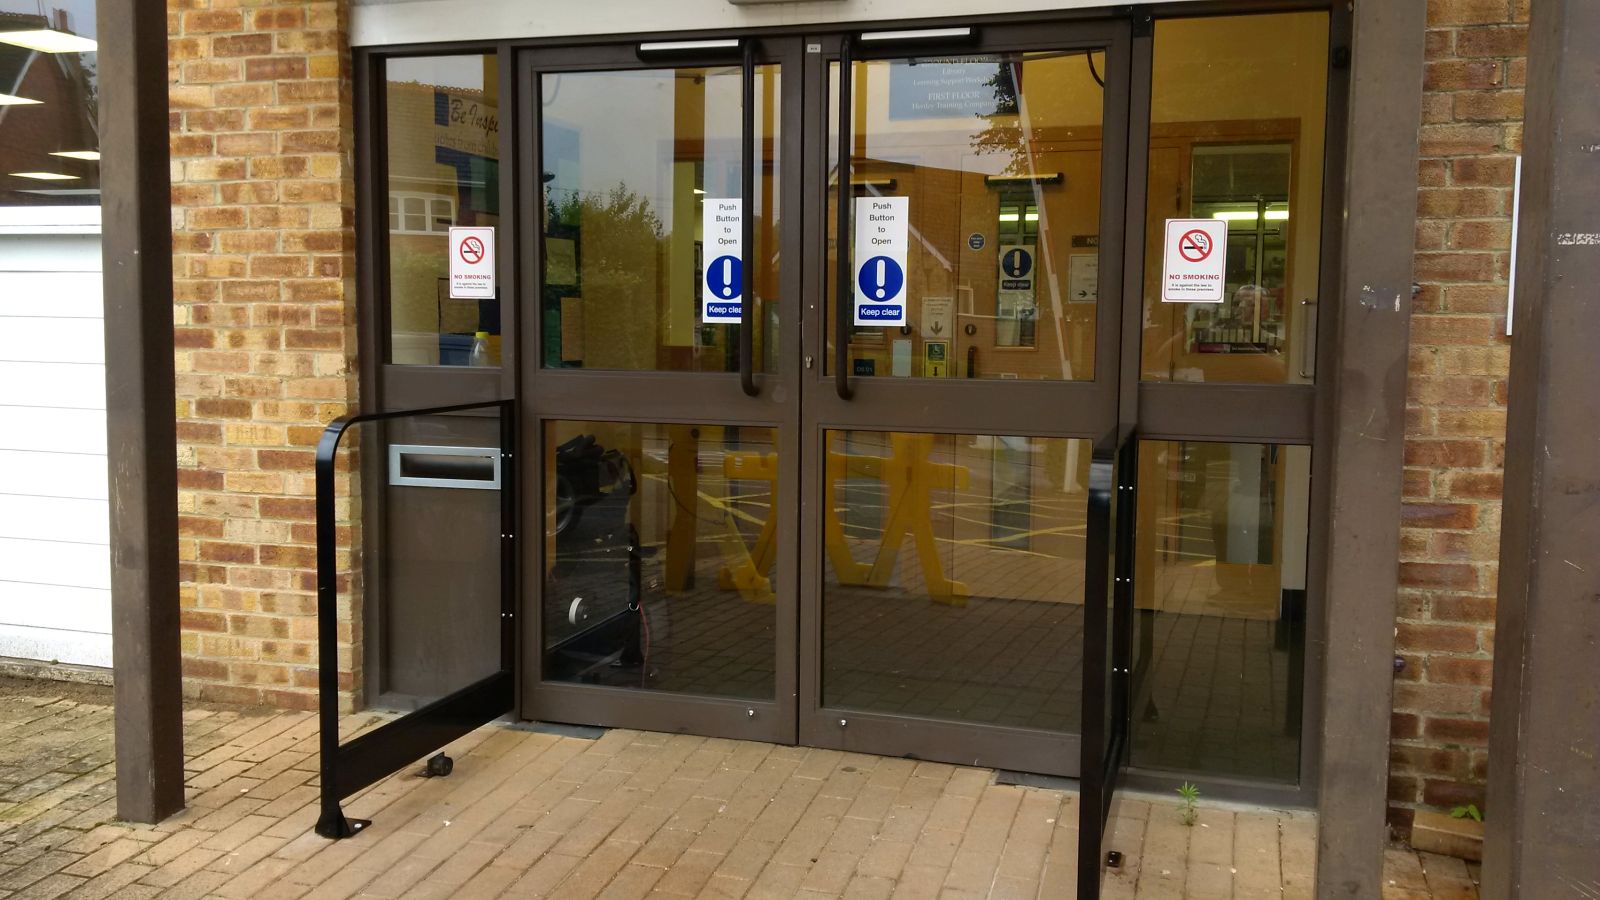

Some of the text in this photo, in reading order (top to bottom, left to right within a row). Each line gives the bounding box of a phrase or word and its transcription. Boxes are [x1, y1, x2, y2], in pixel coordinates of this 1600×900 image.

[941, 77, 965, 86] Support
[928, 91, 981, 101] FIRST FLOOR
[964, 101, 995, 109] Company
[450, 99, 467, 124] Be
[719, 203, 737, 211] Push
[872, 202, 892, 210] Push
[718, 237, 737, 246] Open
[871, 237, 892, 246] Open
[708, 305, 742, 314] Keep clea
[860, 308, 900, 317] Keep clear
